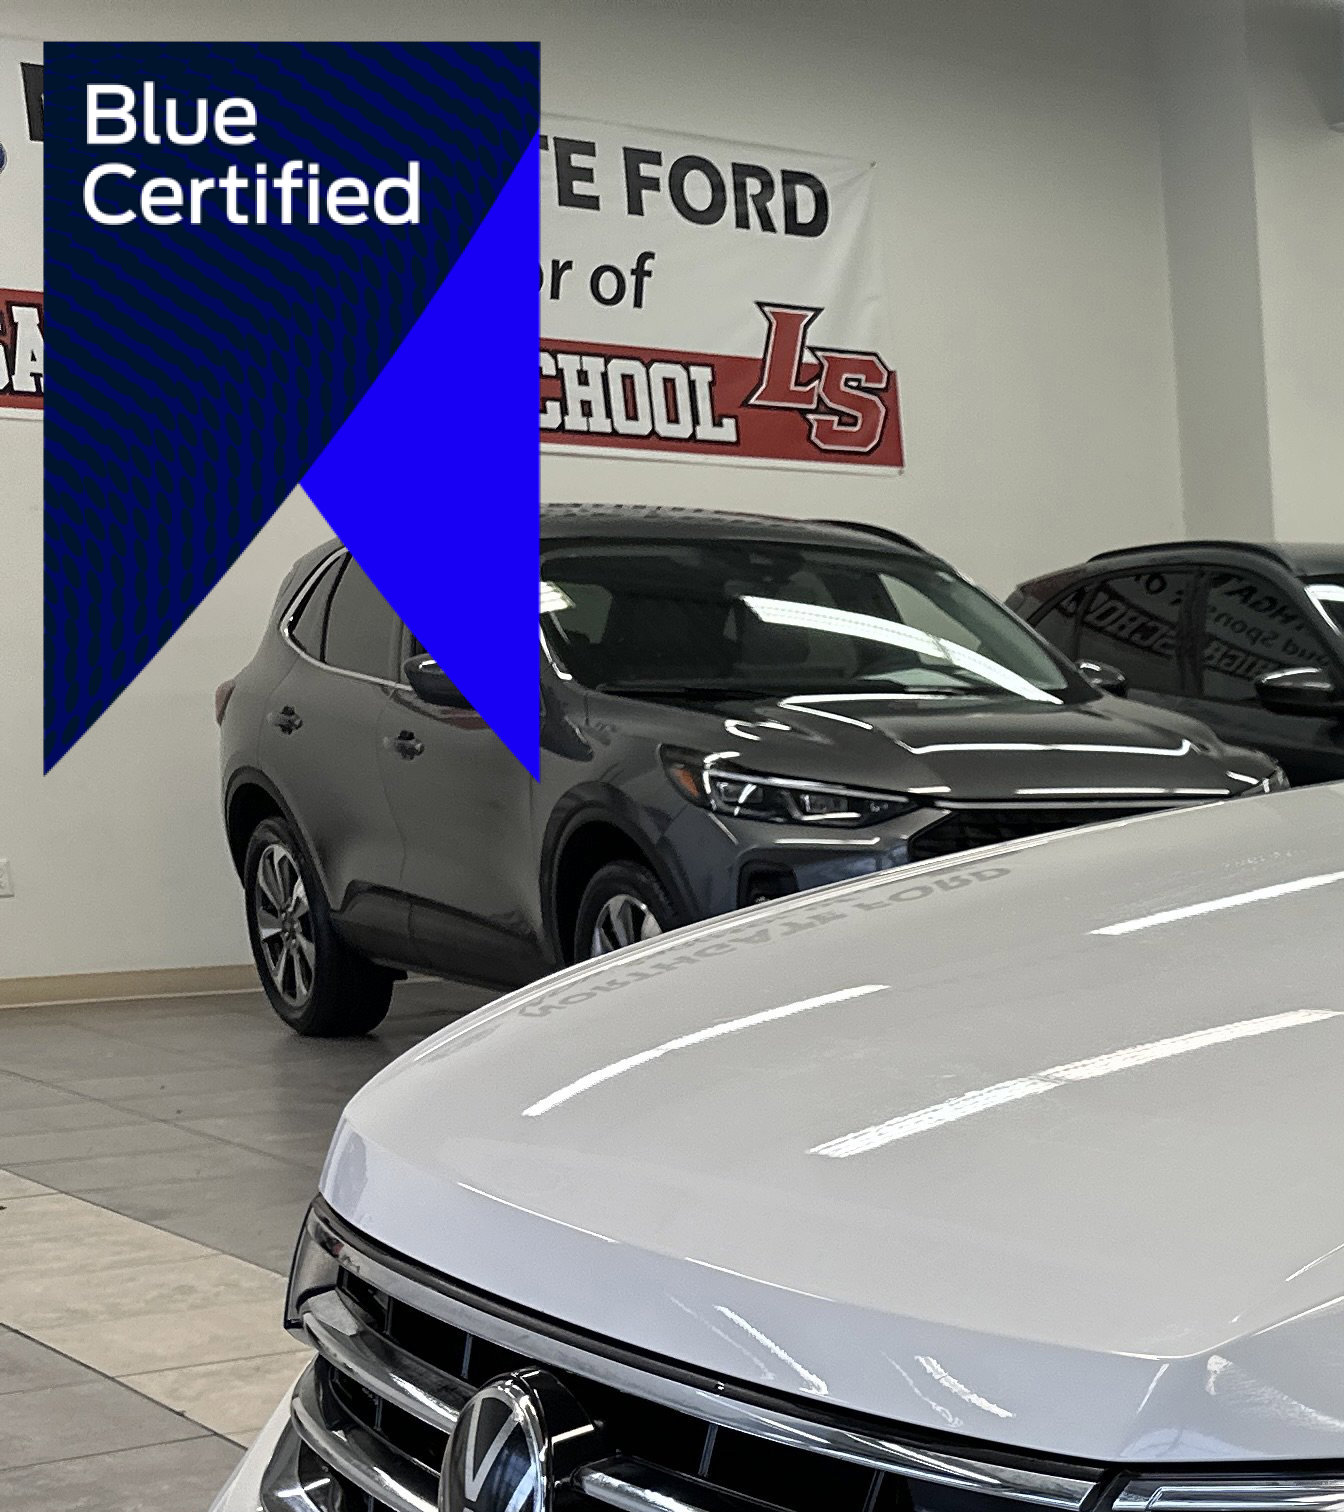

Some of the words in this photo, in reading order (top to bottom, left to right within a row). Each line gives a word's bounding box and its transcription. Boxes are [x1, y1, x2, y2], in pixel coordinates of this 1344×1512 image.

[622, 146, 829, 239] FORD
[590, 251, 656, 308] of
[540, 351, 738, 444] CHOOL
